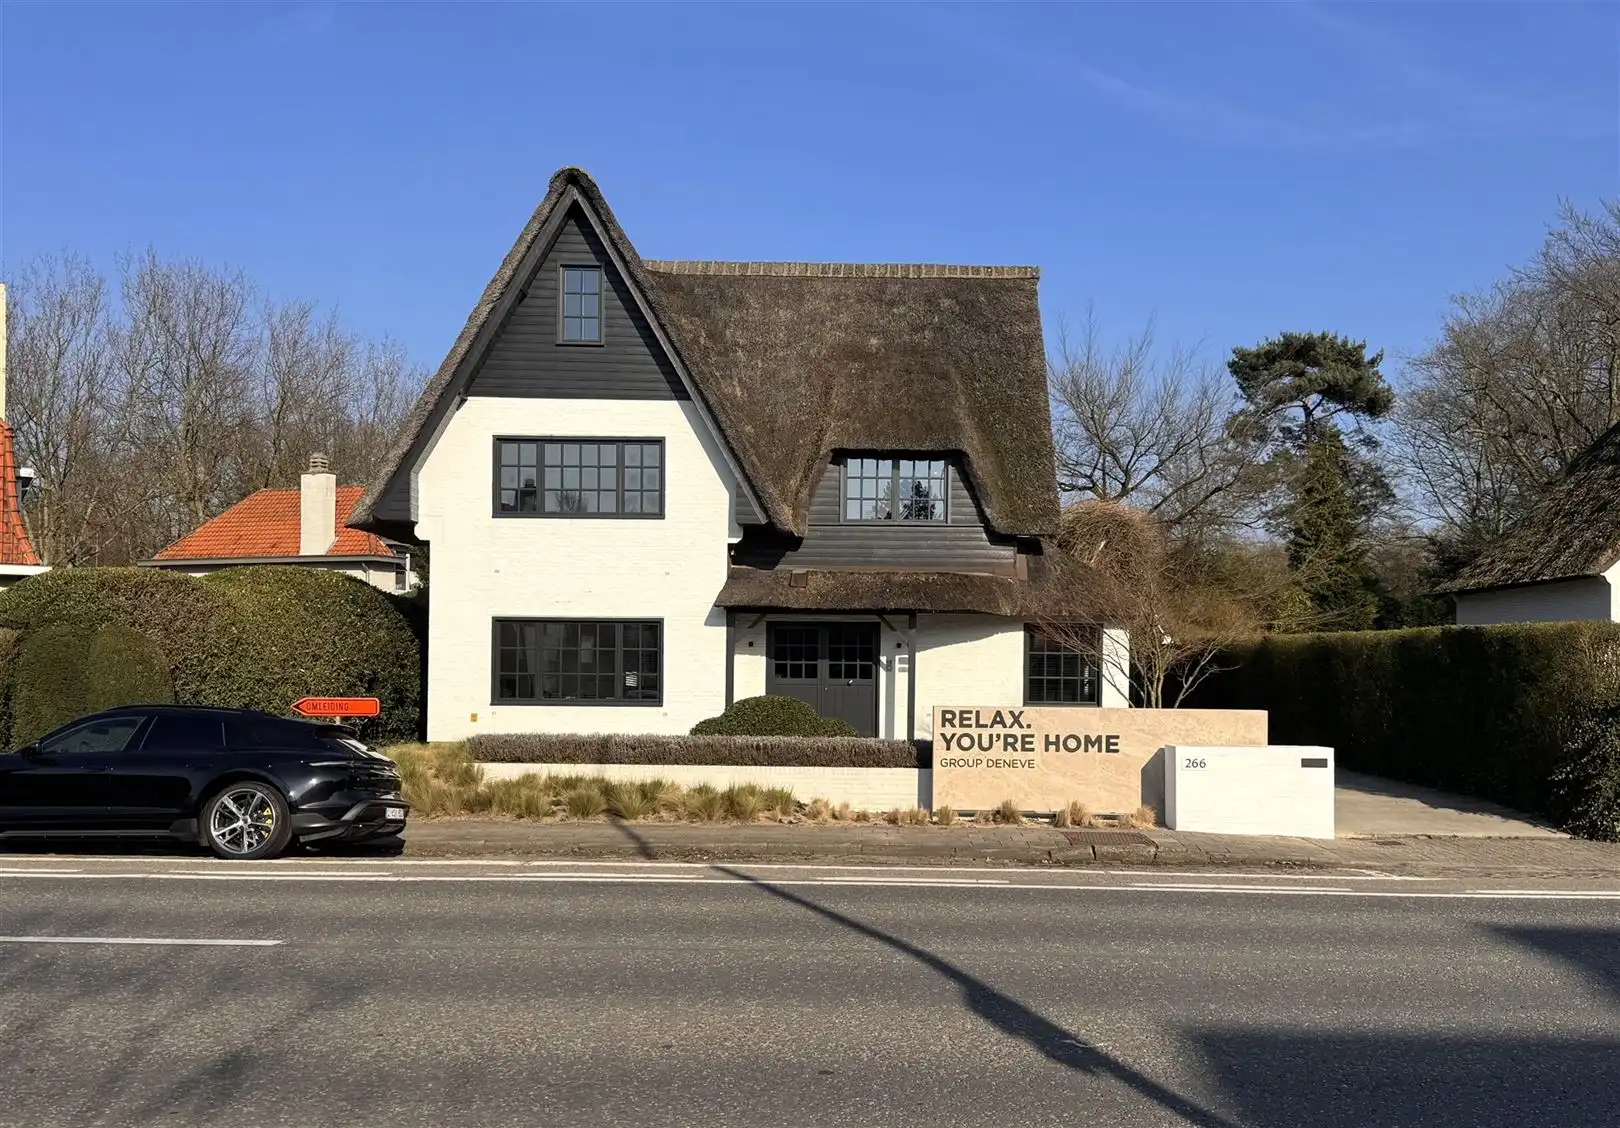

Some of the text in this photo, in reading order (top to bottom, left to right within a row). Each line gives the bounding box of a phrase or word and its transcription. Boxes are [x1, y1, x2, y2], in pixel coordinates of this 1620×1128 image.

[306, 702, 349, 711] OMLEIDING
[941, 709, 1032, 729] RELAX.
[1044, 734, 1120, 753] HOME
[940, 758, 1035, 768] GROUP DENEVE
[1185, 758, 1206, 768] 266
